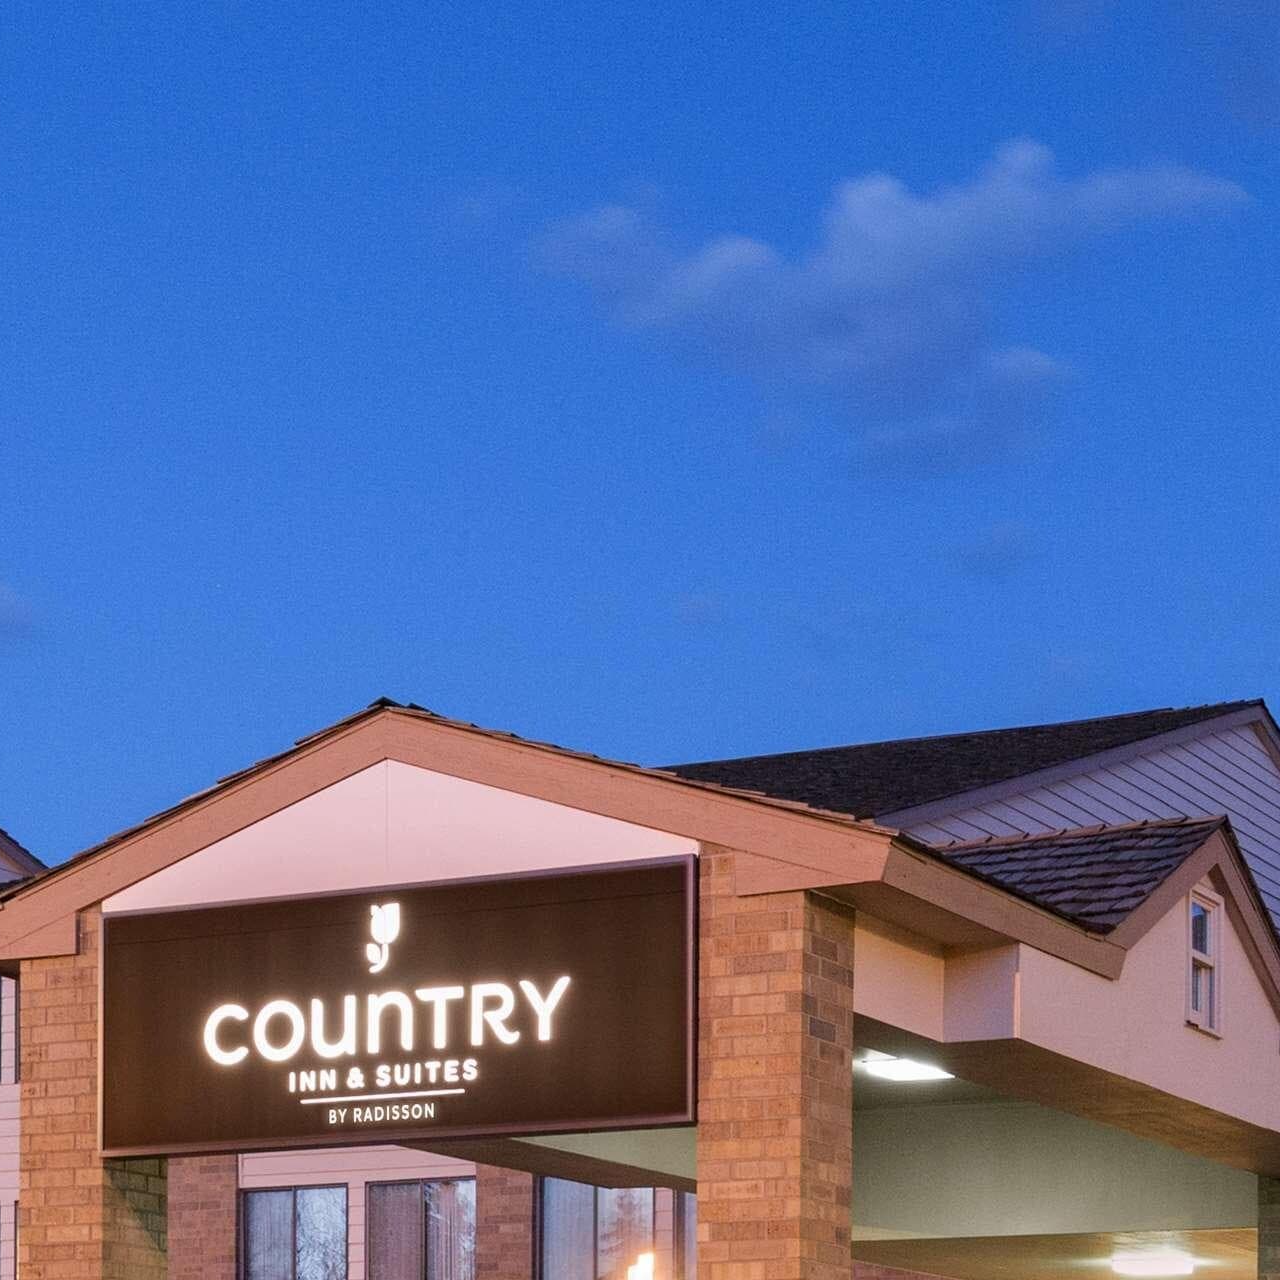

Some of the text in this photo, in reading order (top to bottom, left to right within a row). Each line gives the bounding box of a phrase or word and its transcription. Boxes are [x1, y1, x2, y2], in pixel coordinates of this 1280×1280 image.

[203, 975, 571, 1067] COUNTRY
[288, 1058, 479, 1093] INN & SUITES
[328, 1102, 436, 1125] BY RADISSON
